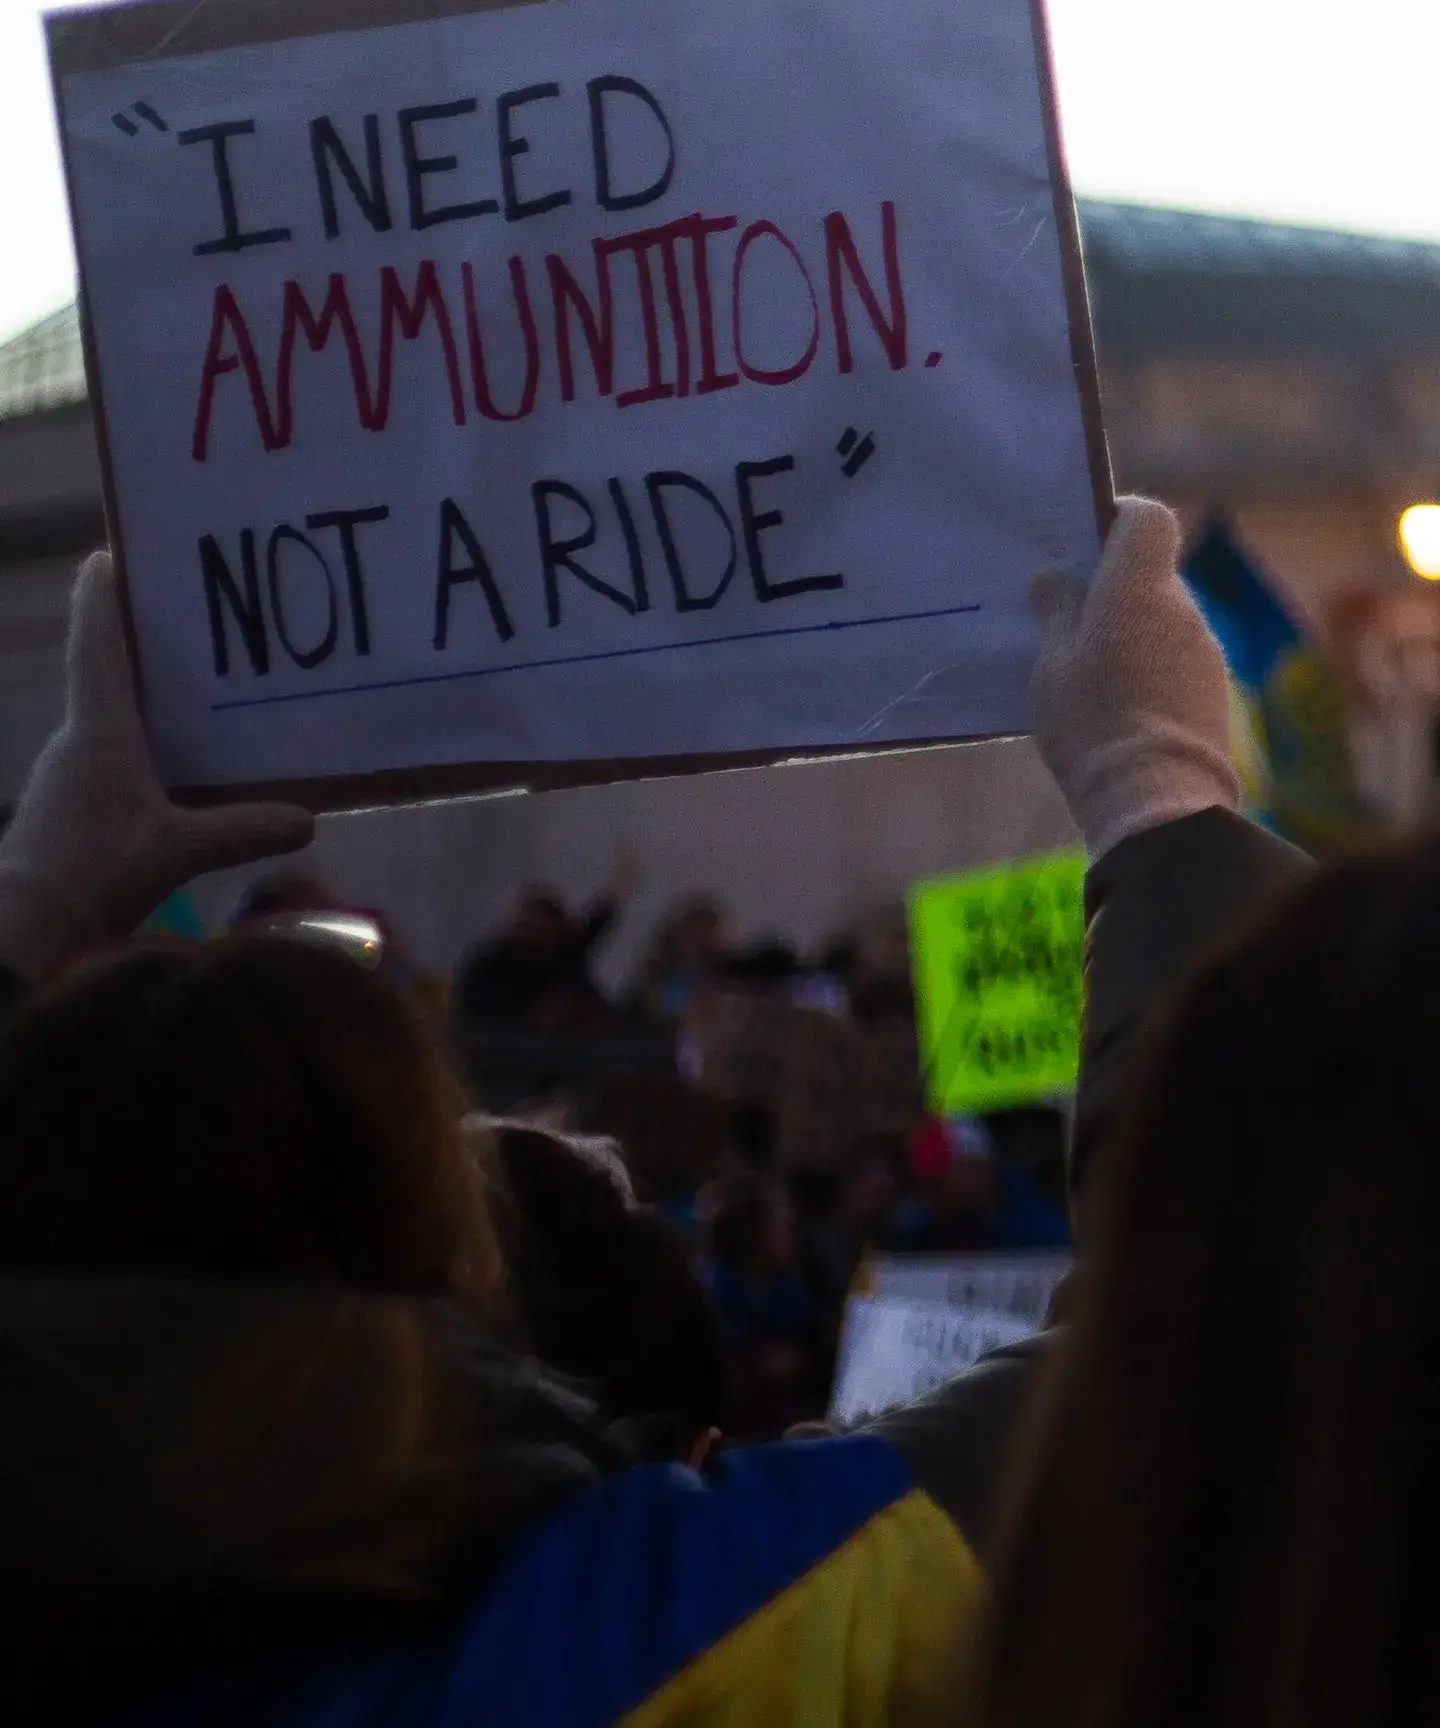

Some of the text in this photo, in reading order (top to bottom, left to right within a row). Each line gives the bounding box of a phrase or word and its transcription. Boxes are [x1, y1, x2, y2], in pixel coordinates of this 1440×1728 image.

[307, 73, 677, 243] NEED
[196, 504, 391, 678] NOT
[431, 496, 516, 652] A
